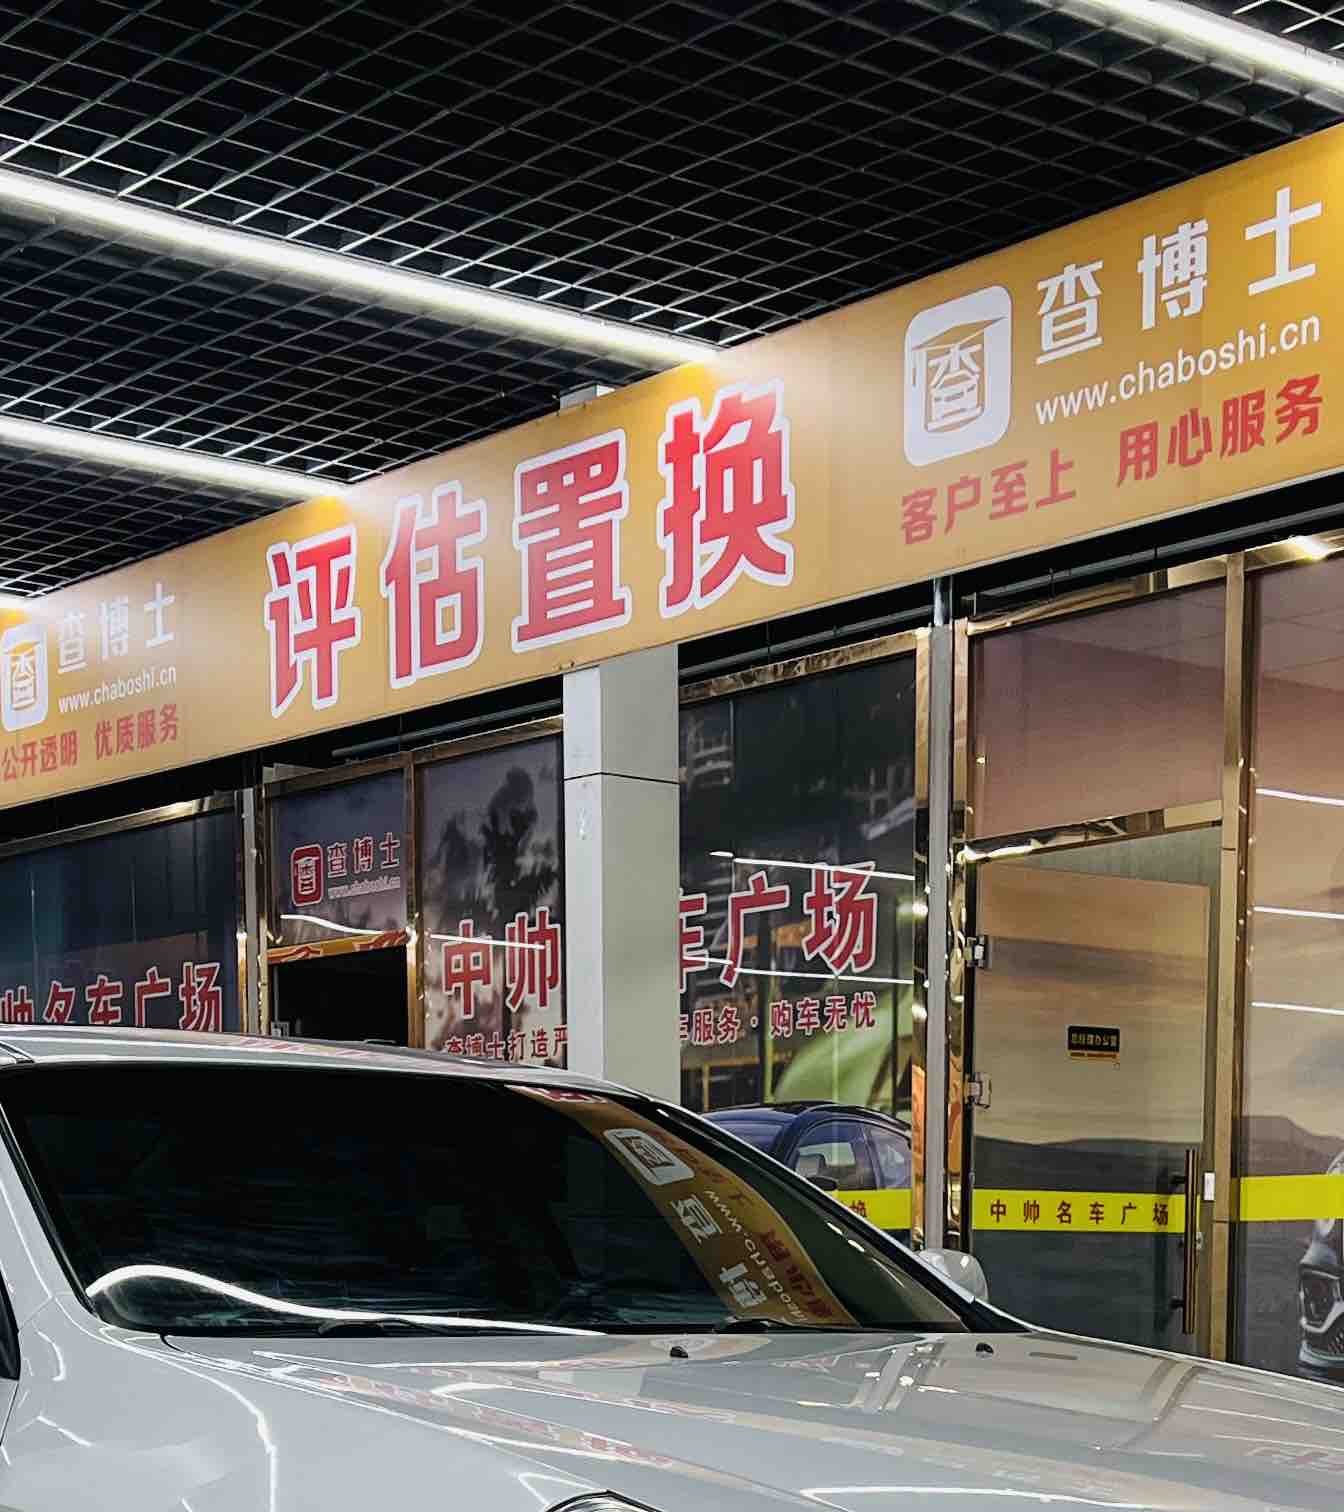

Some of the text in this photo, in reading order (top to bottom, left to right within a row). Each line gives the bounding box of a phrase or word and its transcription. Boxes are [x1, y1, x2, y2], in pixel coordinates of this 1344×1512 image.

[1034, 186, 1324, 365] 查博士
[1034, 313, 1322, 425] www.chaboshi.cn
[900, 373, 1324, 546] 客户至上 用心服务
[263, 377, 795, 718] 评估置换
[57, 582, 176, 675] 查博士
[0, 703, 179, 782] 公开透明 优质服务
[57, 664, 177, 714] www.chaboshi.cn
[442, 906, 562, 1020] 中帅
[989, 1199, 1169, 1226] 中帅名车广场
